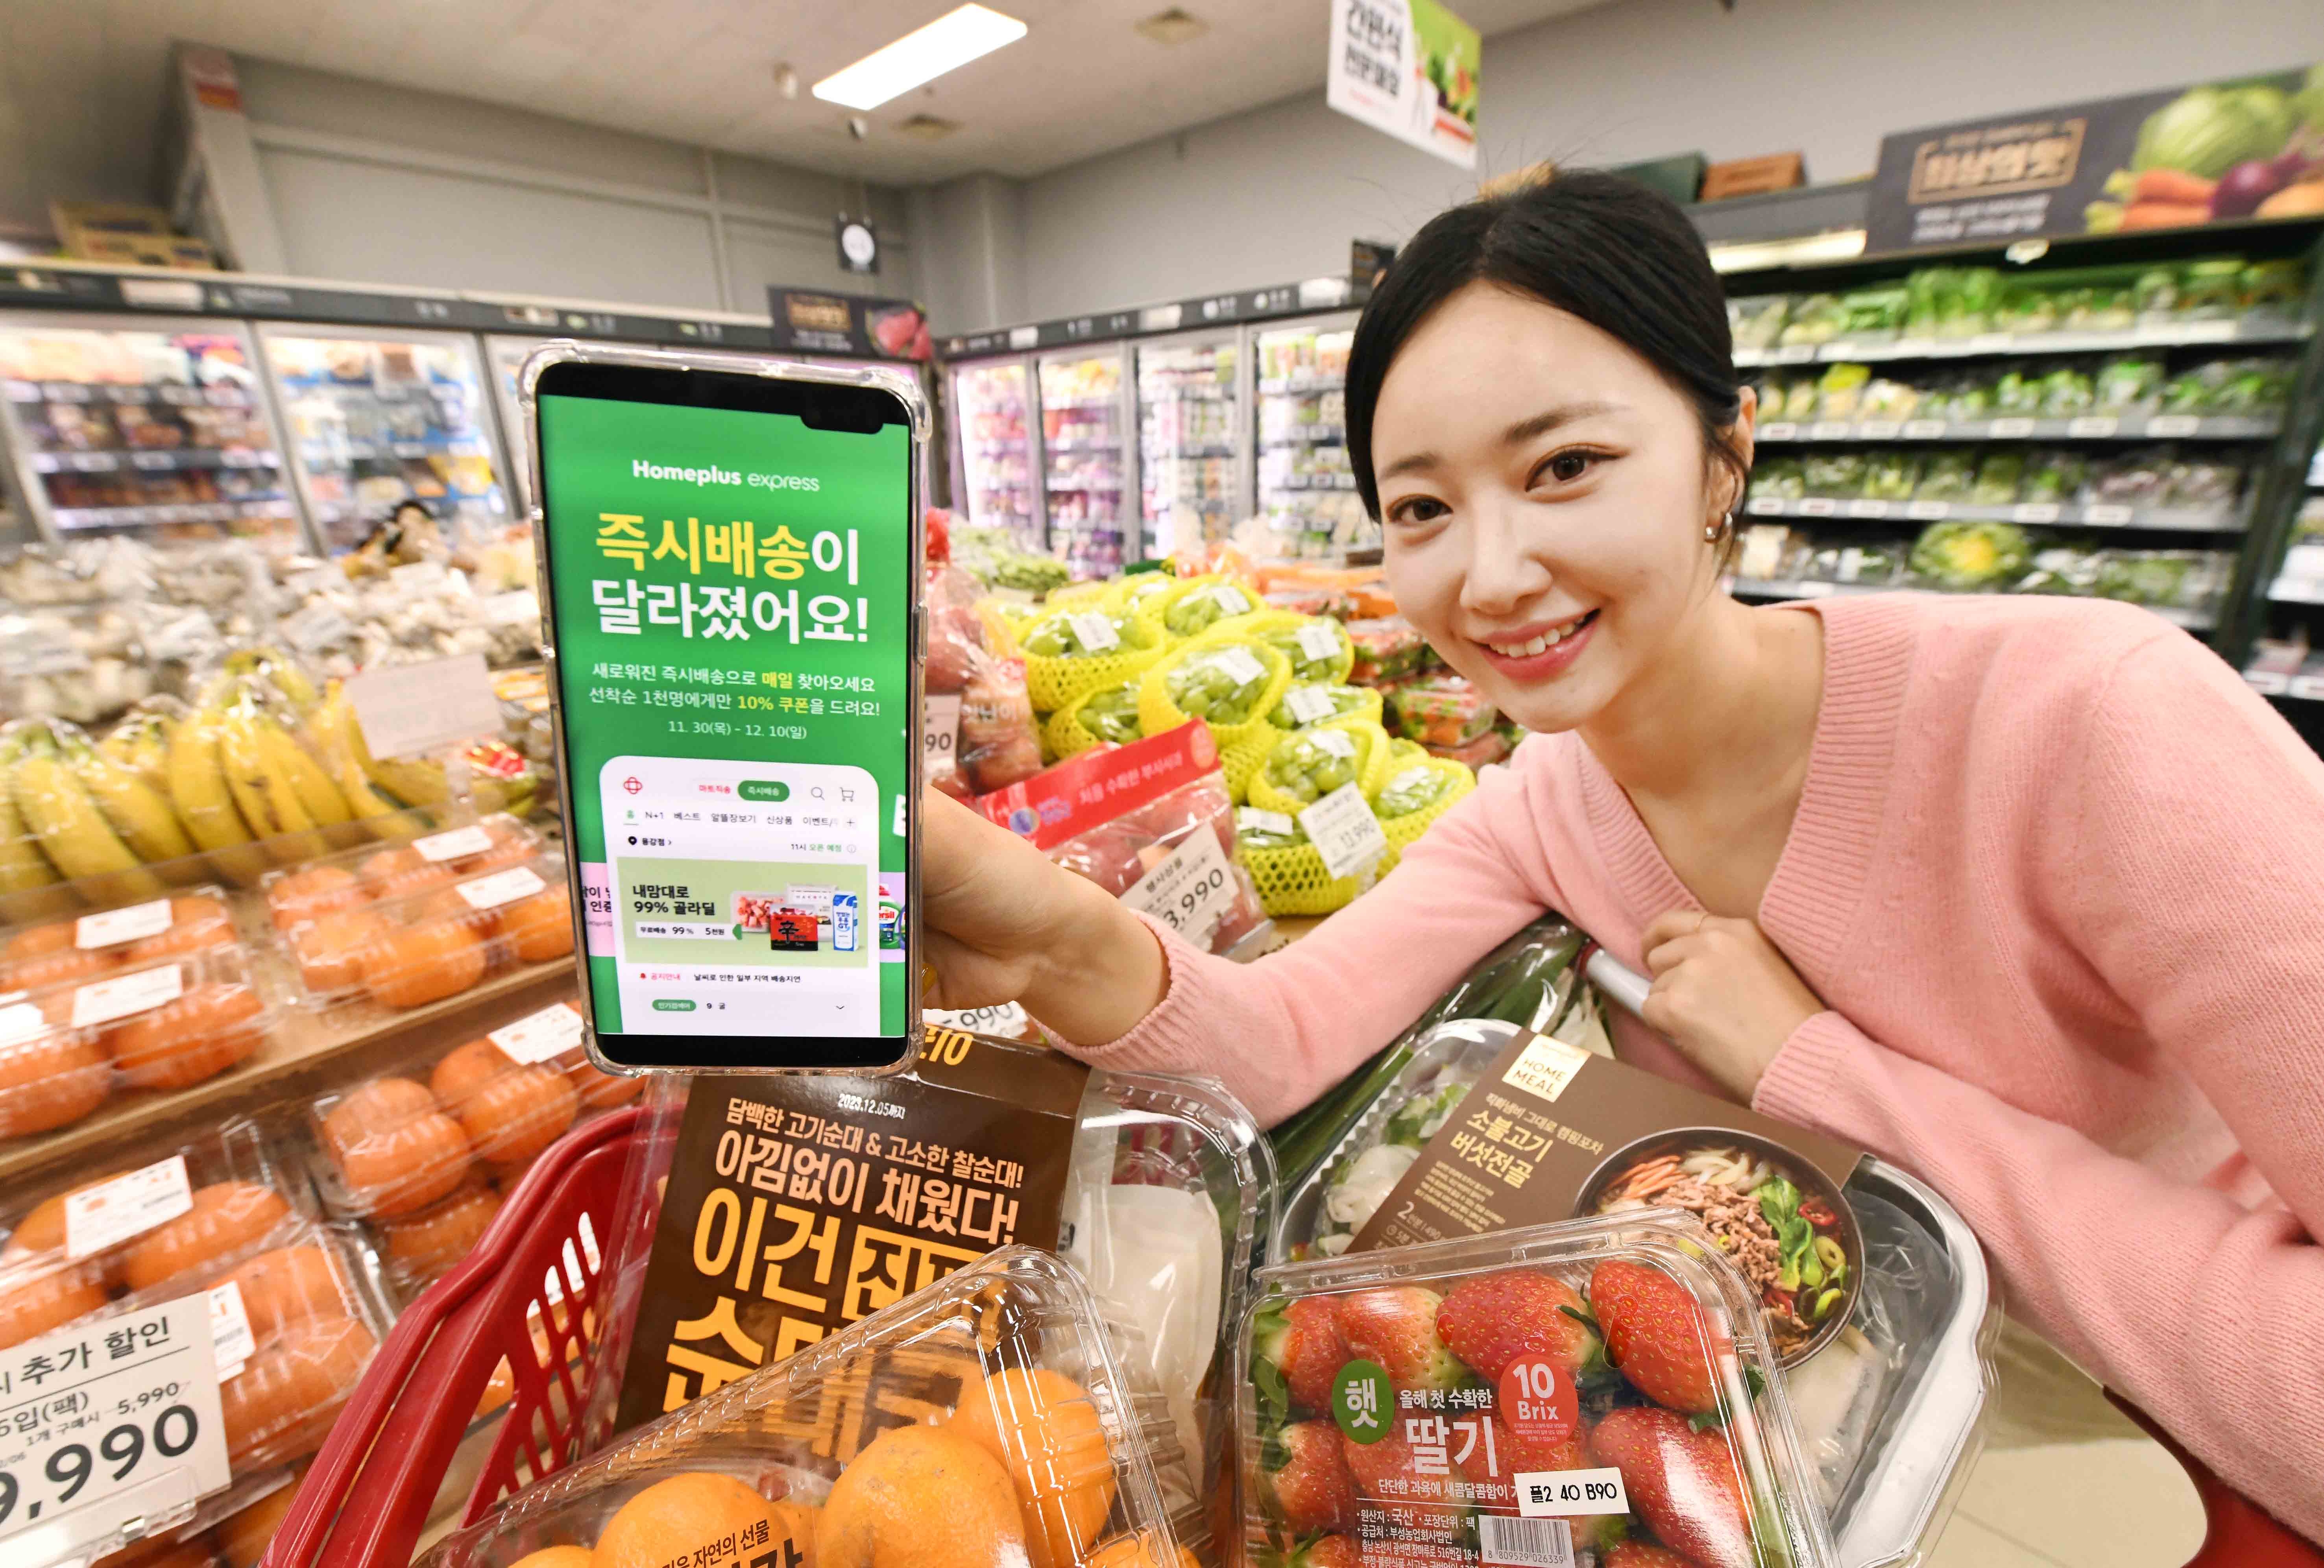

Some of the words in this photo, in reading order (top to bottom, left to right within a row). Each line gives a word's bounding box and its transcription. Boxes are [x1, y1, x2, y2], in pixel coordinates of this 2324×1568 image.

[633, 460, 741, 486] Homeplus
[748, 473, 819, 491] express
[597, 513, 858, 585] 즉시배송이
[592, 579, 868, 644] 달라졌어요!
[593, 663, 656, 681] 새로워진
[661, 666, 756, 685] 즉시배송으로
[762, 671, 792, 689] 매일
[798, 674, 875, 692] 찾아오세요
[589, 687, 637, 706] 선착순
[643, 691, 731, 710] 1천명에게만
[738, 696, 773, 711] 10%
[779, 697, 824, 714] 쿠폰을
[830, 700, 880, 716] 드려요!
[693, 722, 731, 736] 30(목)
[769, 725, 807, 739] 10(일)
[748, 786, 780, 796] 즉시배송
[674, 812, 700, 820] 베스트
[711, 813, 756, 823] 알뜰장보기
[767, 816, 792, 825] 신상품
[1145, 857, 1182, 892] 행사상품
[633, 885, 689, 899] 내맘대로
[1164, 868, 1223, 929] 3,990
[634, 901, 668, 912] 99%
[674, 901, 715, 916] 골라딜
[1514, 1070, 1555, 1094] MEAL
[1523, 1058, 1566, 1081] HOME
[838, 1093, 905, 1119] 2023.12.05까지
[1524, 1111, 1557, 1133] 그대로
[726, 1098, 784, 1134] 담백한
[785, 1112, 863, 1152] 고기순대
[866, 1133, 881, 1156] &
[885, 1136, 949, 1170] 고소한
[952, 1150, 1023, 1188] 찰순대!
[1466, 1109, 1554, 1163] 소불고기
[1450, 1131, 1534, 1189] 버섯전골
[715, 1129, 869, 1213] 아낌없이
[876, 1168, 1019, 1245] 채웠다!
[1424, 1226, 1446, 1240] 490
[693, 1188, 841, 1313] 이건
[20, 1342, 92, 1385] 추가
[104, 1317, 170, 1360] 할인
[1513, 1363, 1554, 1398] 10
[1345, 1379, 1378, 1428] 햇
[1400, 1389, 1428, 1409] 올해
[1430, 1389, 1445, 1409] 첫
[1448, 1388, 1492, 1409] 수확한
[1518, 1401, 1559, 1420] Brix
[26, 1427, 50, 1447] 1개
[56, 1411, 100, 1435] 구매시
[118, 1382, 179, 1415] 5,990
[1405, 1416, 1498, 1477] 딸기
[1379, 1479, 1408, 1494] 단단한
[1410, 1481, 1441, 1496] 과육에
[1444, 1482, 1508, 1500] 새콤달콤함이
[1561, 1485, 1580, 1501] 40
[1585, 1483, 1617, 1500] B90
[1361, 1509, 1384, 1523] 원산지
[1392, 1508, 1413, 1526] 국산
[1424, 1514, 1458, 1529] 포장단위
[1466, 1516, 1475, 1530] 팩
[693, 1533, 736, 1568] 자연의
[740, 1519, 770, 1551] 선물
[1362, 1524, 1384, 1538] 공급처
[1390, 1527, 1452, 1544] 부성농업회사법인
[1362, 1539, 1373, 1553] 충남
[1375, 1541, 1392, 1554] 논산시
[1393, 1542, 1411, 1556] 광석면
[1412, 1545, 1436, 1557] 장마루로
[1437, 1547, 1462, 1561] 516번길
[1463, 1549, 1479, 1561] 18-4
[1488, 1550, 1492, 1559] 8
[1498, 1551, 1529, 1561] 809529
[1532, 1553, 1563, 1564] 026339
